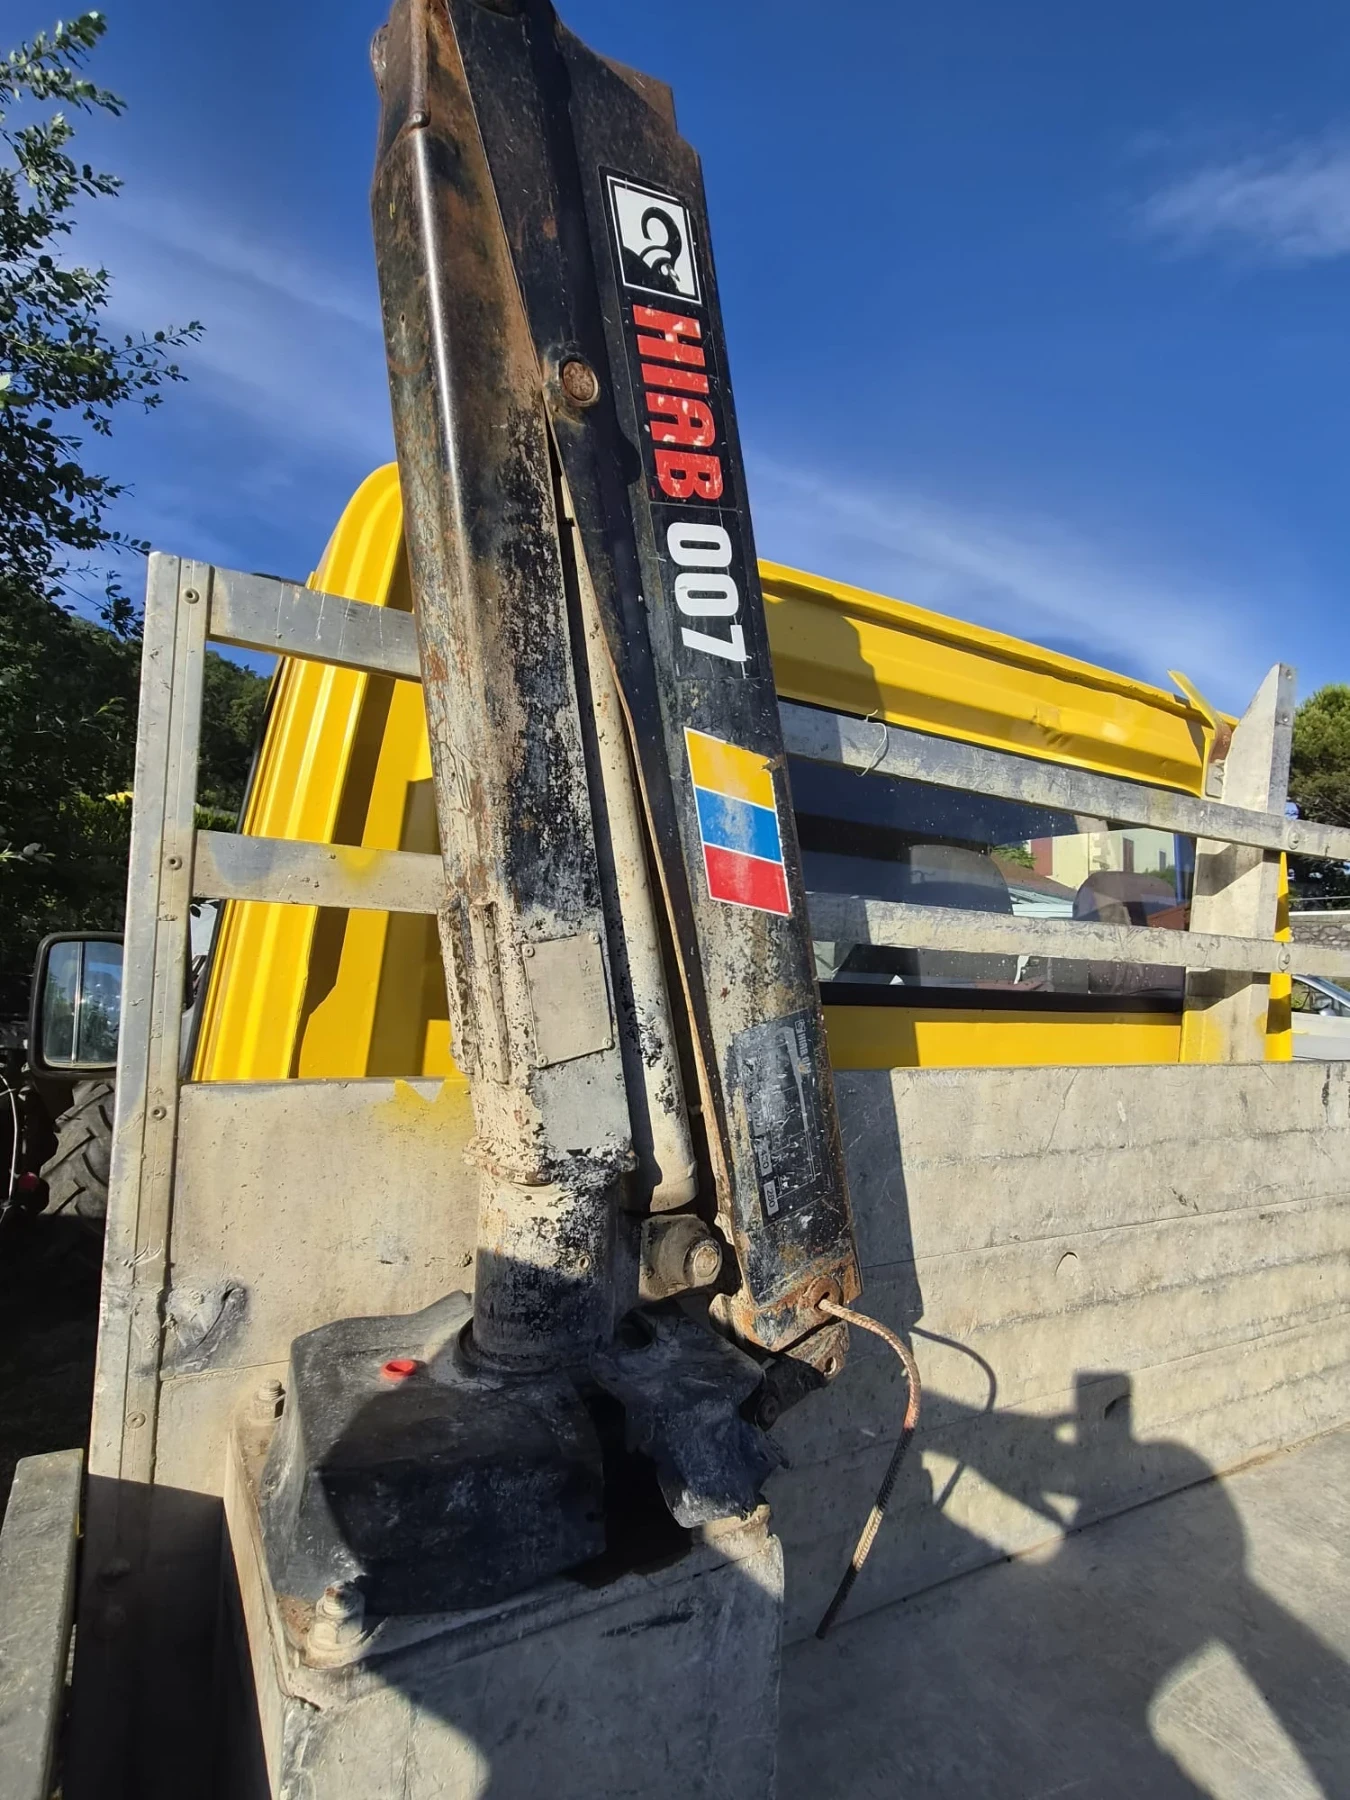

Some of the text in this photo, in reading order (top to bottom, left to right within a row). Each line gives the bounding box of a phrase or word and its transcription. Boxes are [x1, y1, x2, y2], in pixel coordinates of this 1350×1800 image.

[632, 304, 747, 663] HIAB 007
[798, 1031, 809, 1057] HIAB
[766, 1187, 776, 1208] 280
